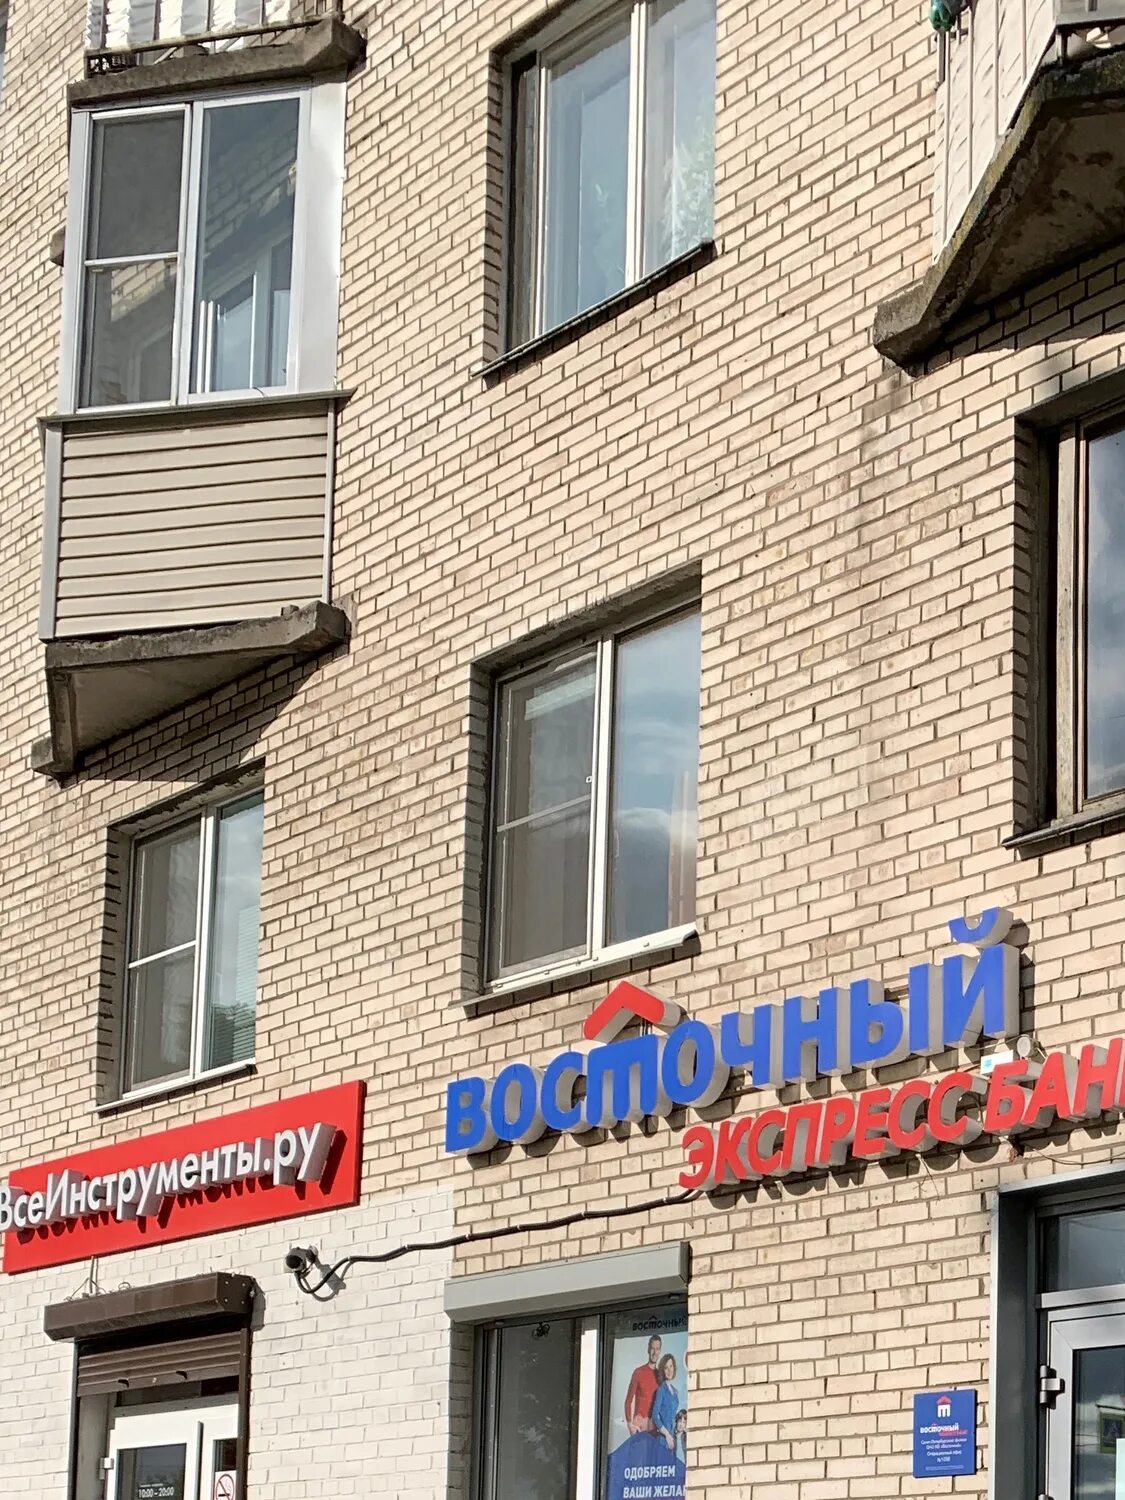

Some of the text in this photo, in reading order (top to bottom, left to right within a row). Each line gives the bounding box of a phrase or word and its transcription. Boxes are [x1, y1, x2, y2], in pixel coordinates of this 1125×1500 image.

[679, 1072, 976, 1190] ЭКСПРЕСС
[0, 1122, 328, 1231] ВсеИнструменты.ру
[623, 1486, 652, 1499] ВАШИ
[624, 1465, 676, 1480] ОДОБРЯЕМ
